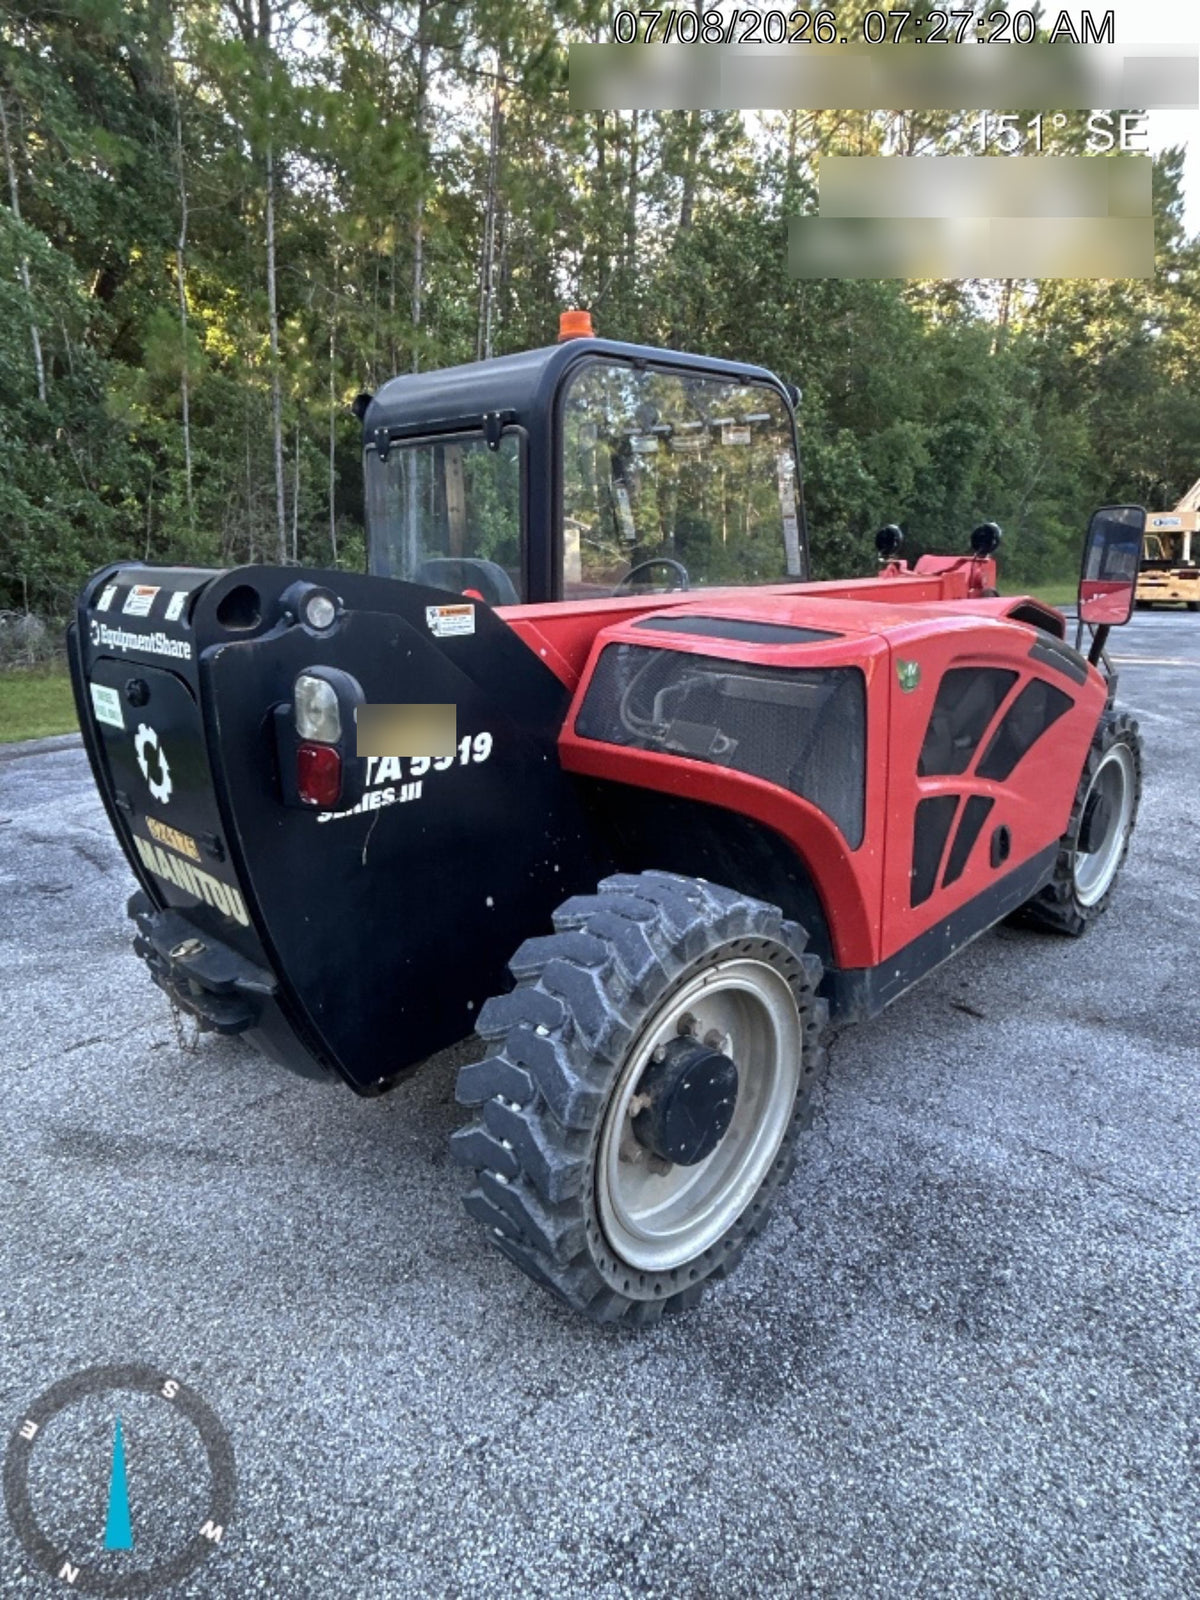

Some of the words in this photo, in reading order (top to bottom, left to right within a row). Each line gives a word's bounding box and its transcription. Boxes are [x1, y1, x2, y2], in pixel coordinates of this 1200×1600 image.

[100, 623, 192, 660] EquipmentShare
[317, 787, 397, 822] IES
[133, 834, 249, 927] MANITOU
